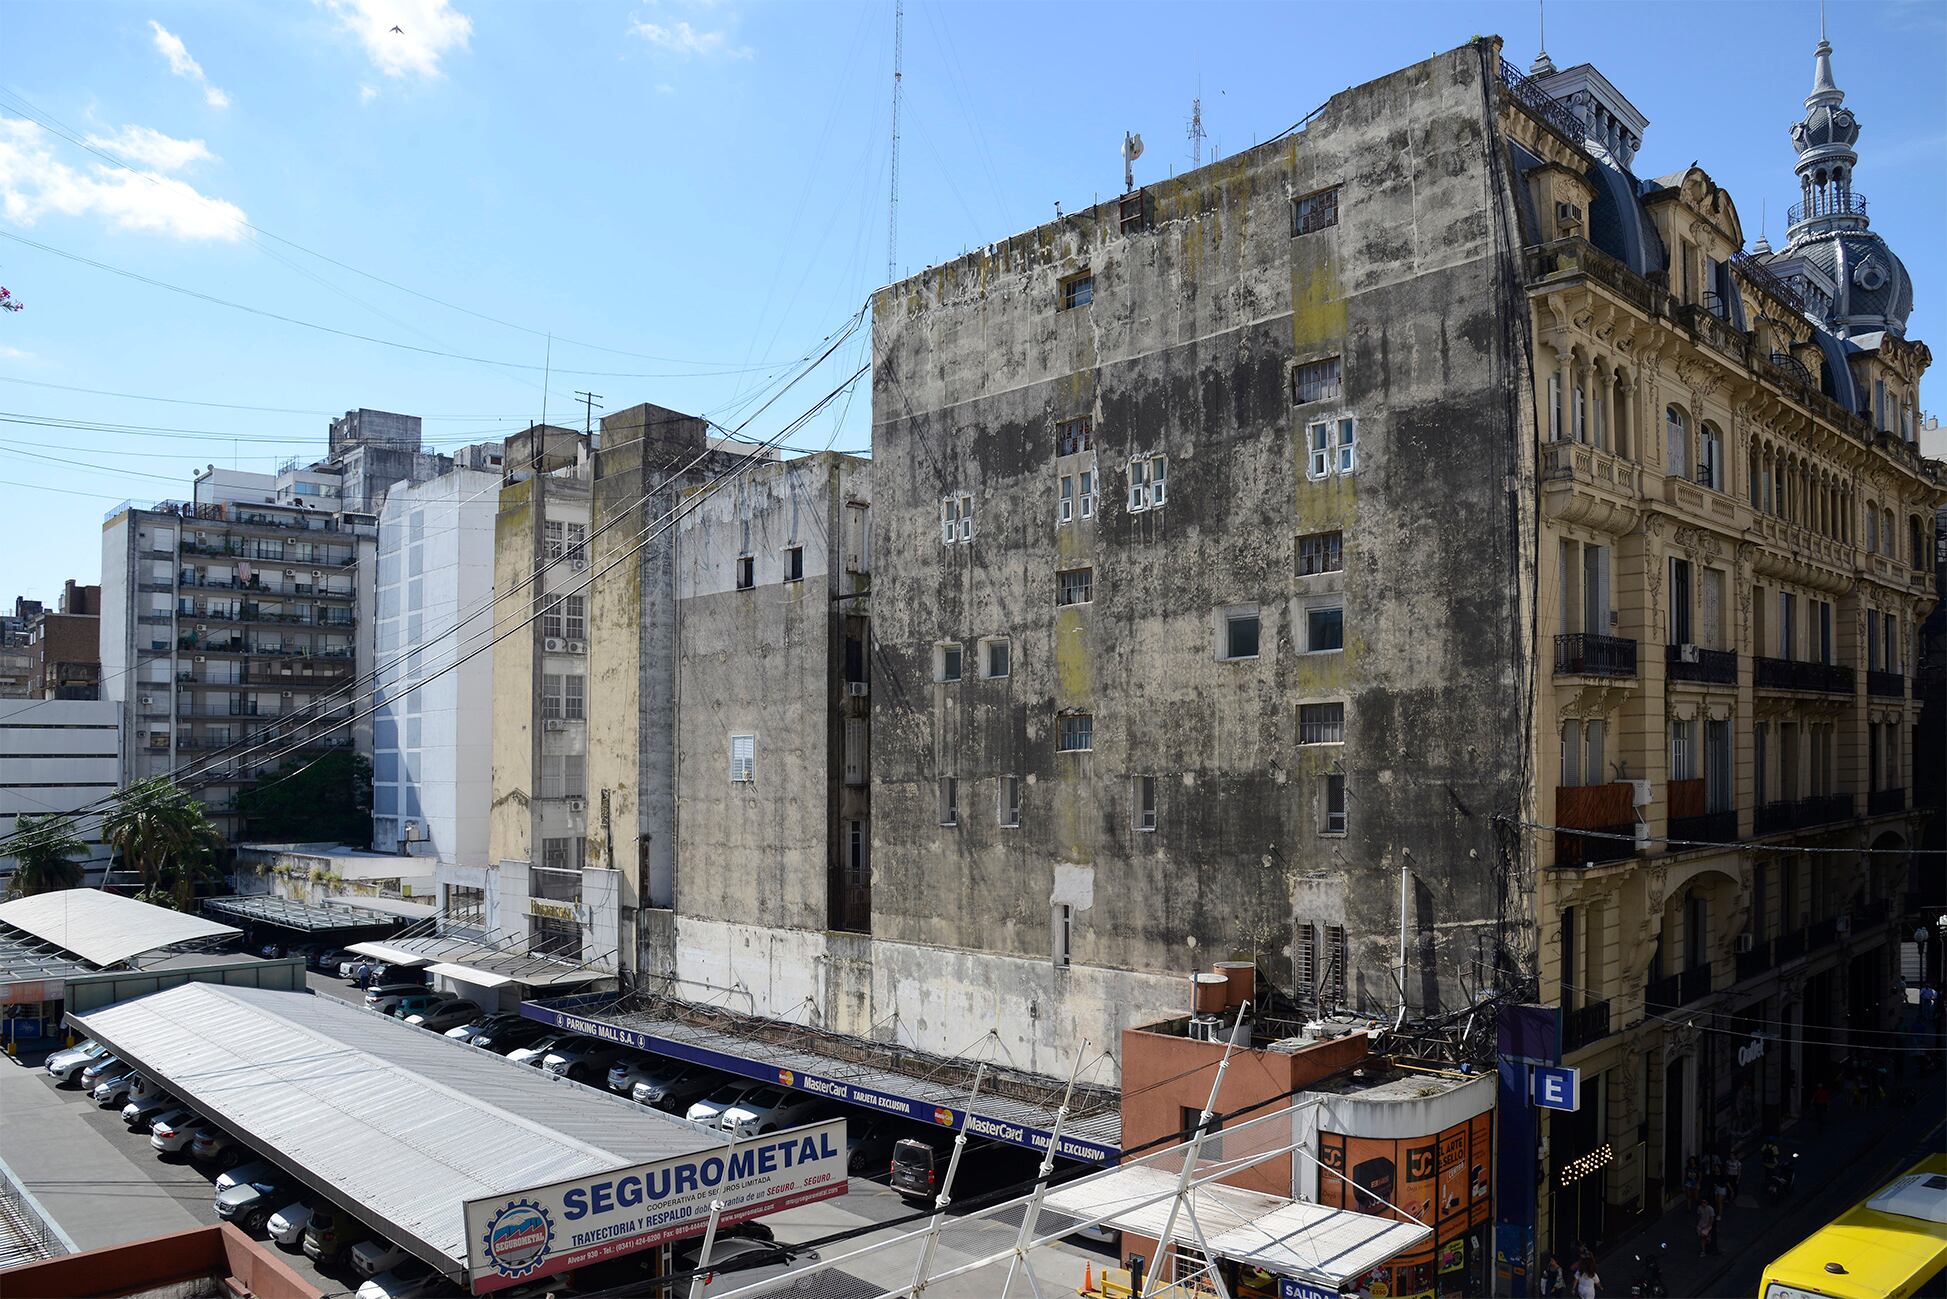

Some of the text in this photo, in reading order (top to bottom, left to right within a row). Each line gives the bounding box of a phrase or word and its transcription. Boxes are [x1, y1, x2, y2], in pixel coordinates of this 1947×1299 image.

[566, 1018, 635, 1045] PARKING MALL S.A.
[803, 1076, 848, 1098] MasterCard
[1545, 1075, 1564, 1103] E
[853, 1091, 910, 1113] TARJETA EXCLUSIVA
[966, 1116, 1024, 1142] MasterCard
[1031, 1134, 1105, 1160] TARJA EXCLUSIVA
[1446, 1137, 1463, 1153] ARTE
[563, 1132, 838, 1220] SEGUROMETAL
[647, 1194, 697, 1212] COOPERATIVA
[697, 1191, 706, 1199] DE
[741, 1176, 771, 1189] LIMITADA
[571, 1221, 636, 1246] TRAYECTORIA
[638, 1218, 644, 1229] Y
[646, 1205, 692, 1228] RESPALDO
[694, 1203, 712, 1215] dobl
[746, 1192, 755, 1202] de
[756, 1190, 765, 1199] un
[495, 1232, 545, 1252] SEGUROMETAL
[567, 1254, 586, 1264] Alvear
[587, 1250, 598, 1260] 930
[615, 1240, 634, 1252] (0341)
[1285, 1285, 1329, 1299] SALID
